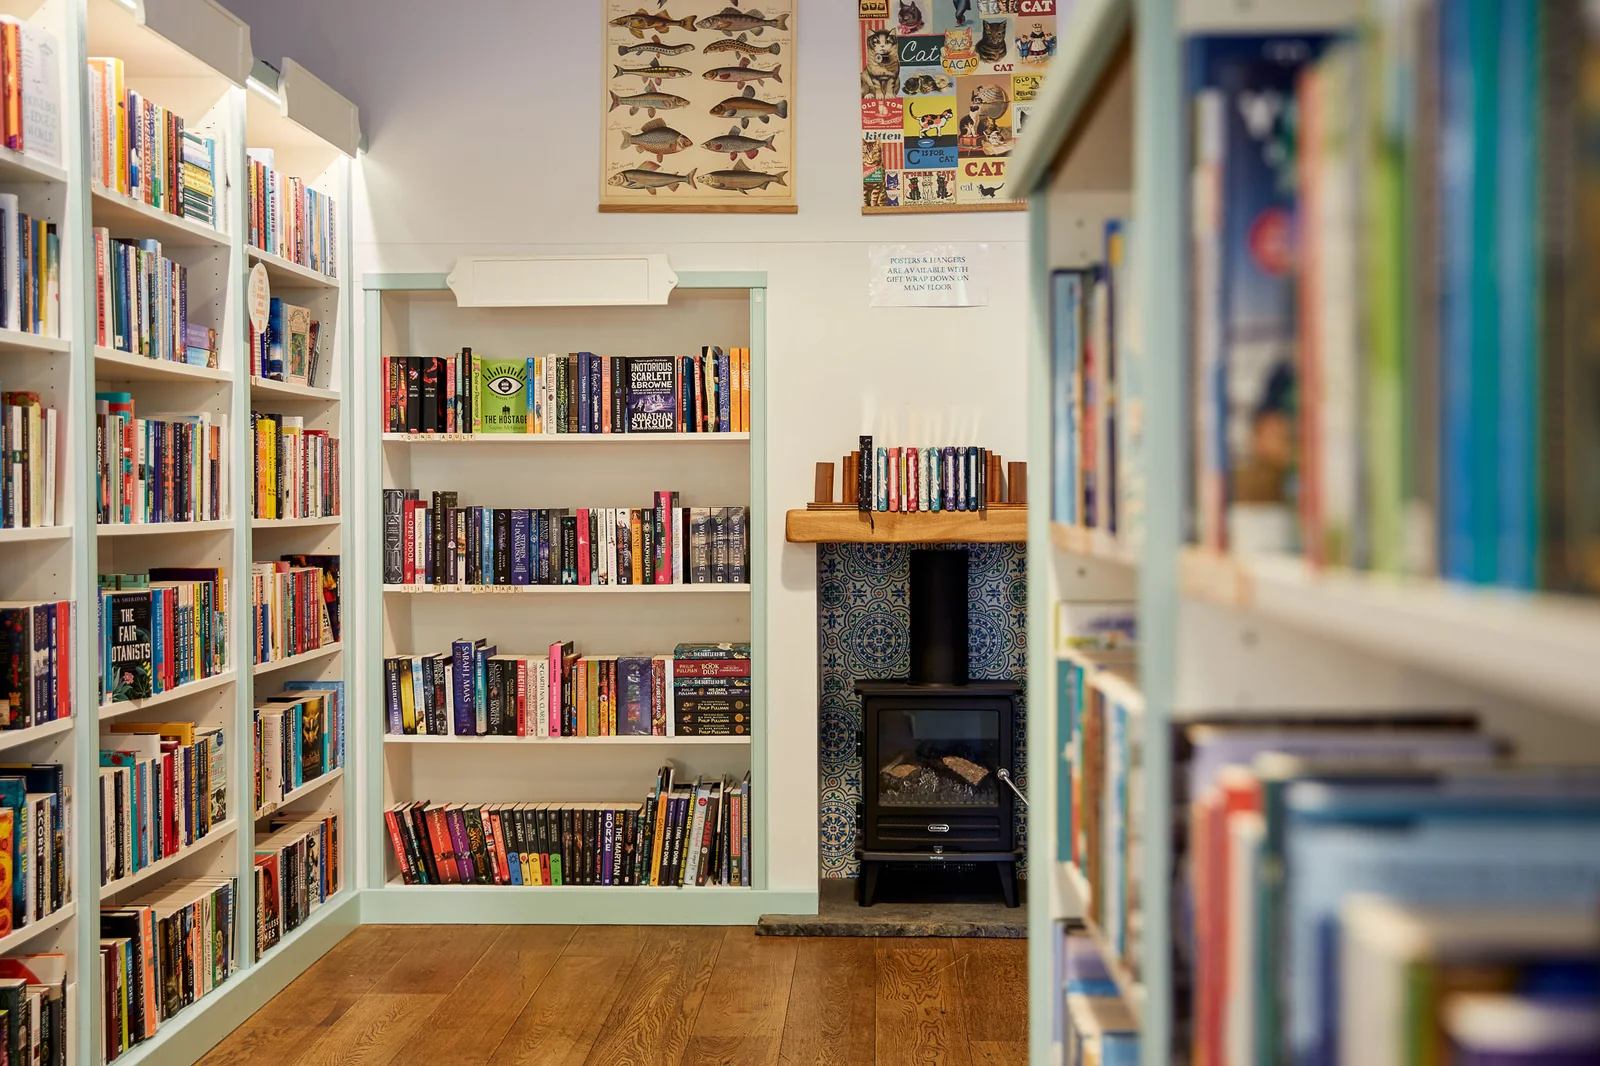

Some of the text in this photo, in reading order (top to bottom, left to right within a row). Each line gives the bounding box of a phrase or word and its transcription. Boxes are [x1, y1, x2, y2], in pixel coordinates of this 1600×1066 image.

[1021, 0, 1052, 13] CAT
[902, 41, 939, 62] Cat
[942, 57, 978, 69] CACAO
[993, 64, 1013, 72] CAT
[886, 101, 902, 109] TOM
[865, 132, 901, 140] kitten
[907, 150, 920, 164] C
[965, 162, 1005, 176] CAT
[960, 183, 973, 191] cat
[634, 363, 672, 372] NOTORIOUS
[632, 372, 672, 381] SCARLETT
[485, 415, 527, 424] THE HOSTAGE
[632, 413, 673, 421] JONATHAN
[632, 419, 673, 428] STROUD
[121, 609, 134, 622] THE
[120, 625, 137, 642] FAIR
[703, 821, 711, 845] MAUS
[613, 827, 623, 875] THE MARTIAN
